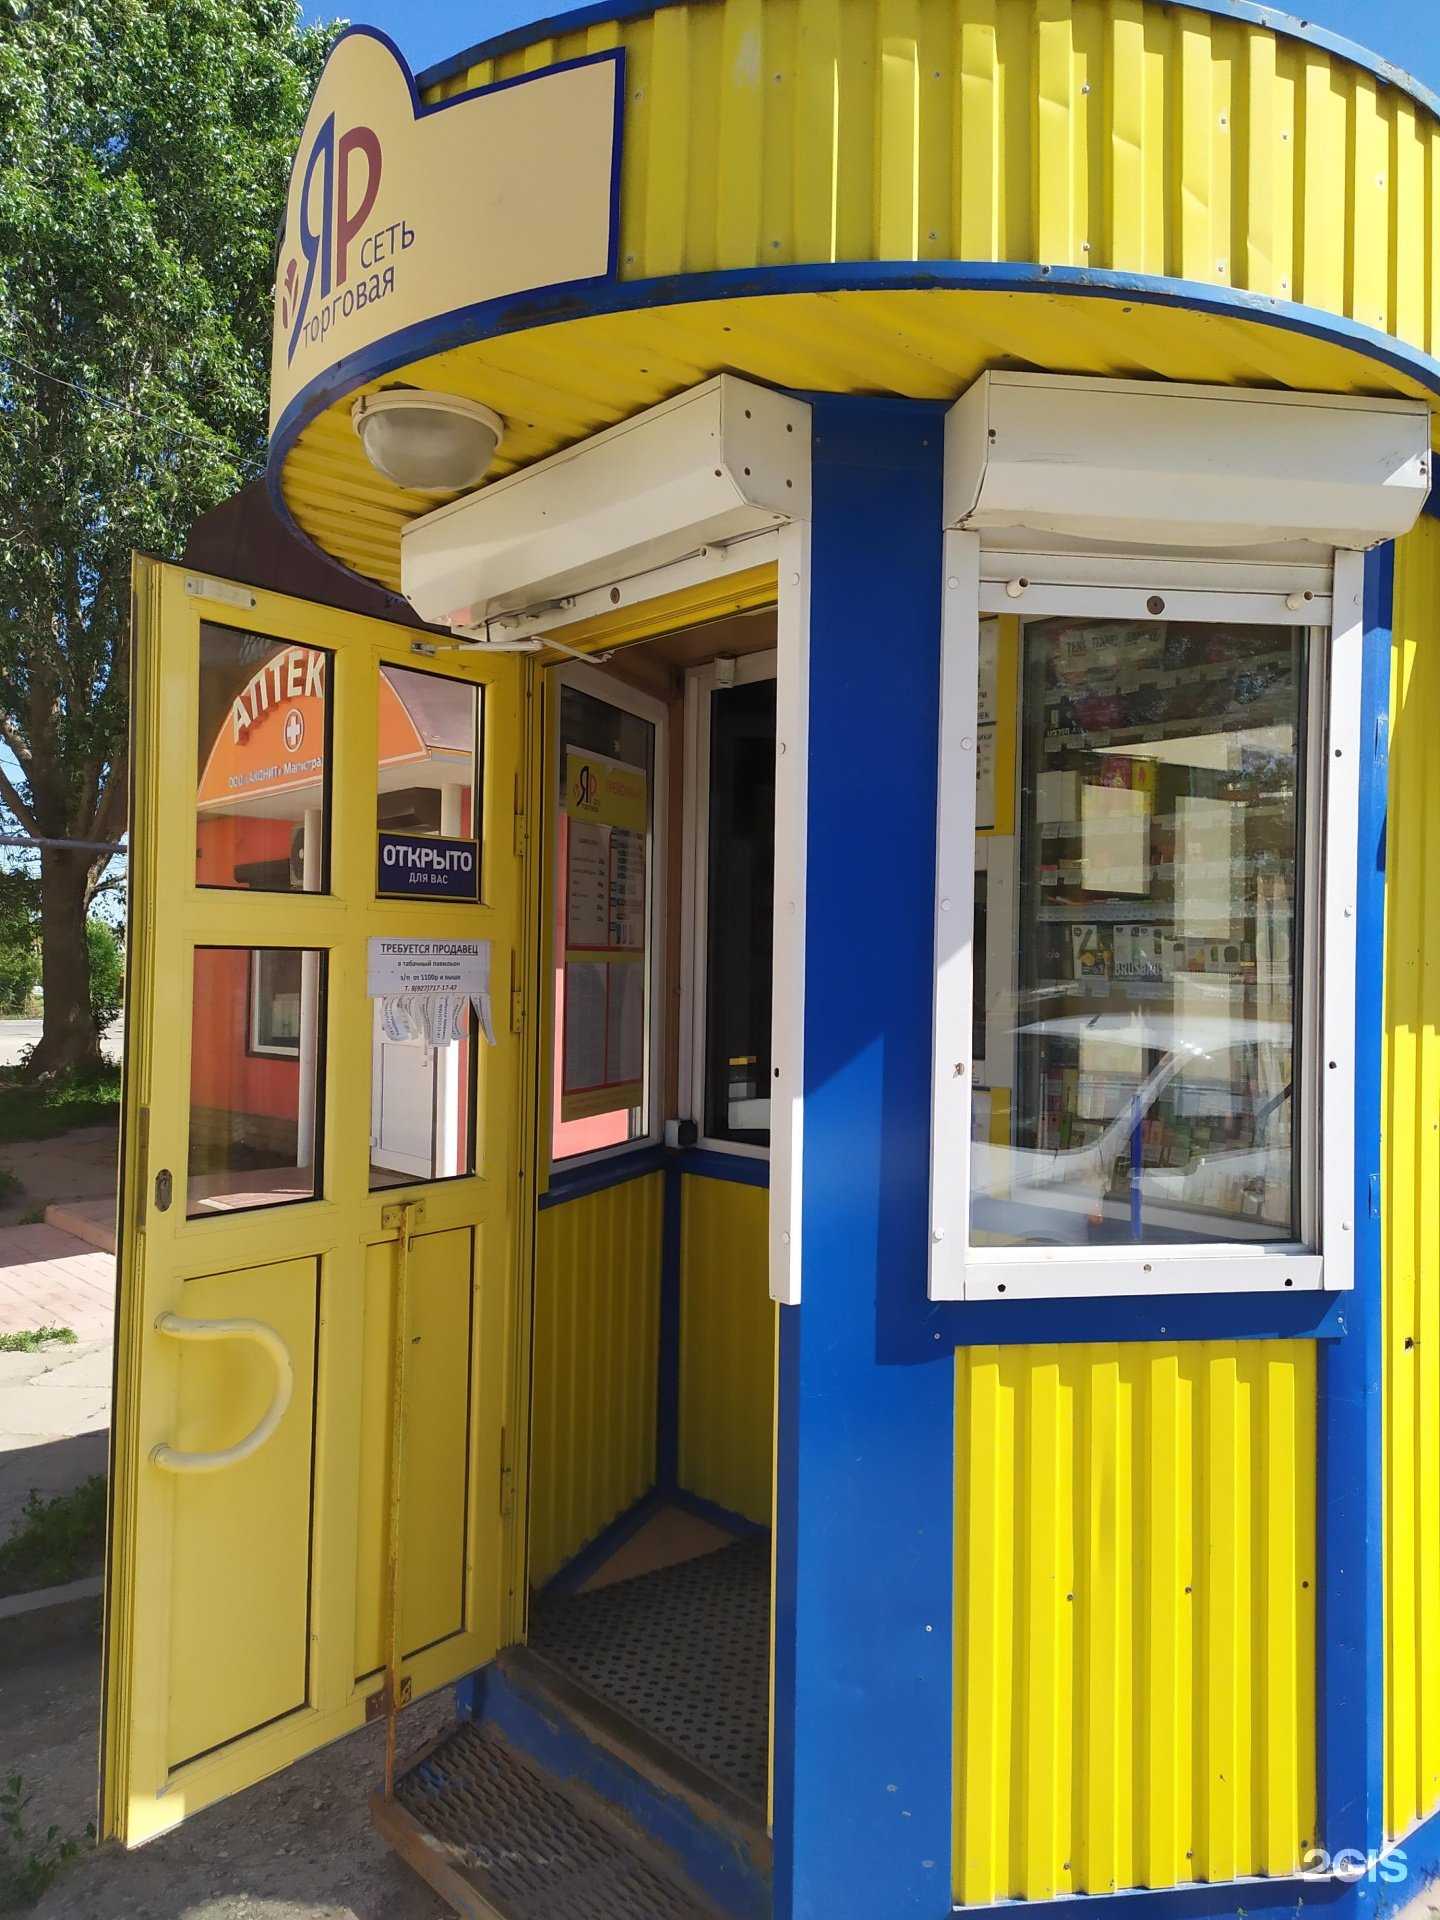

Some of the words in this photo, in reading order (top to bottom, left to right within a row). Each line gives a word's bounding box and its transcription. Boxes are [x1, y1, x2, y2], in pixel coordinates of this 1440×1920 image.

[287, 111, 382, 370] ЯР
[231, 649, 326, 746] АПТЕК
[283, 756, 323, 777] Магистра
[383, 844, 473, 872] ОТКРЫТО
[408, 872, 429, 884] ДЛЯ
[430, 873, 449, 885] ВАС
[381, 943, 430, 954] ТРЕБУЕТСЯ
[432, 944, 479, 955] ПРОДАВЕЦ
